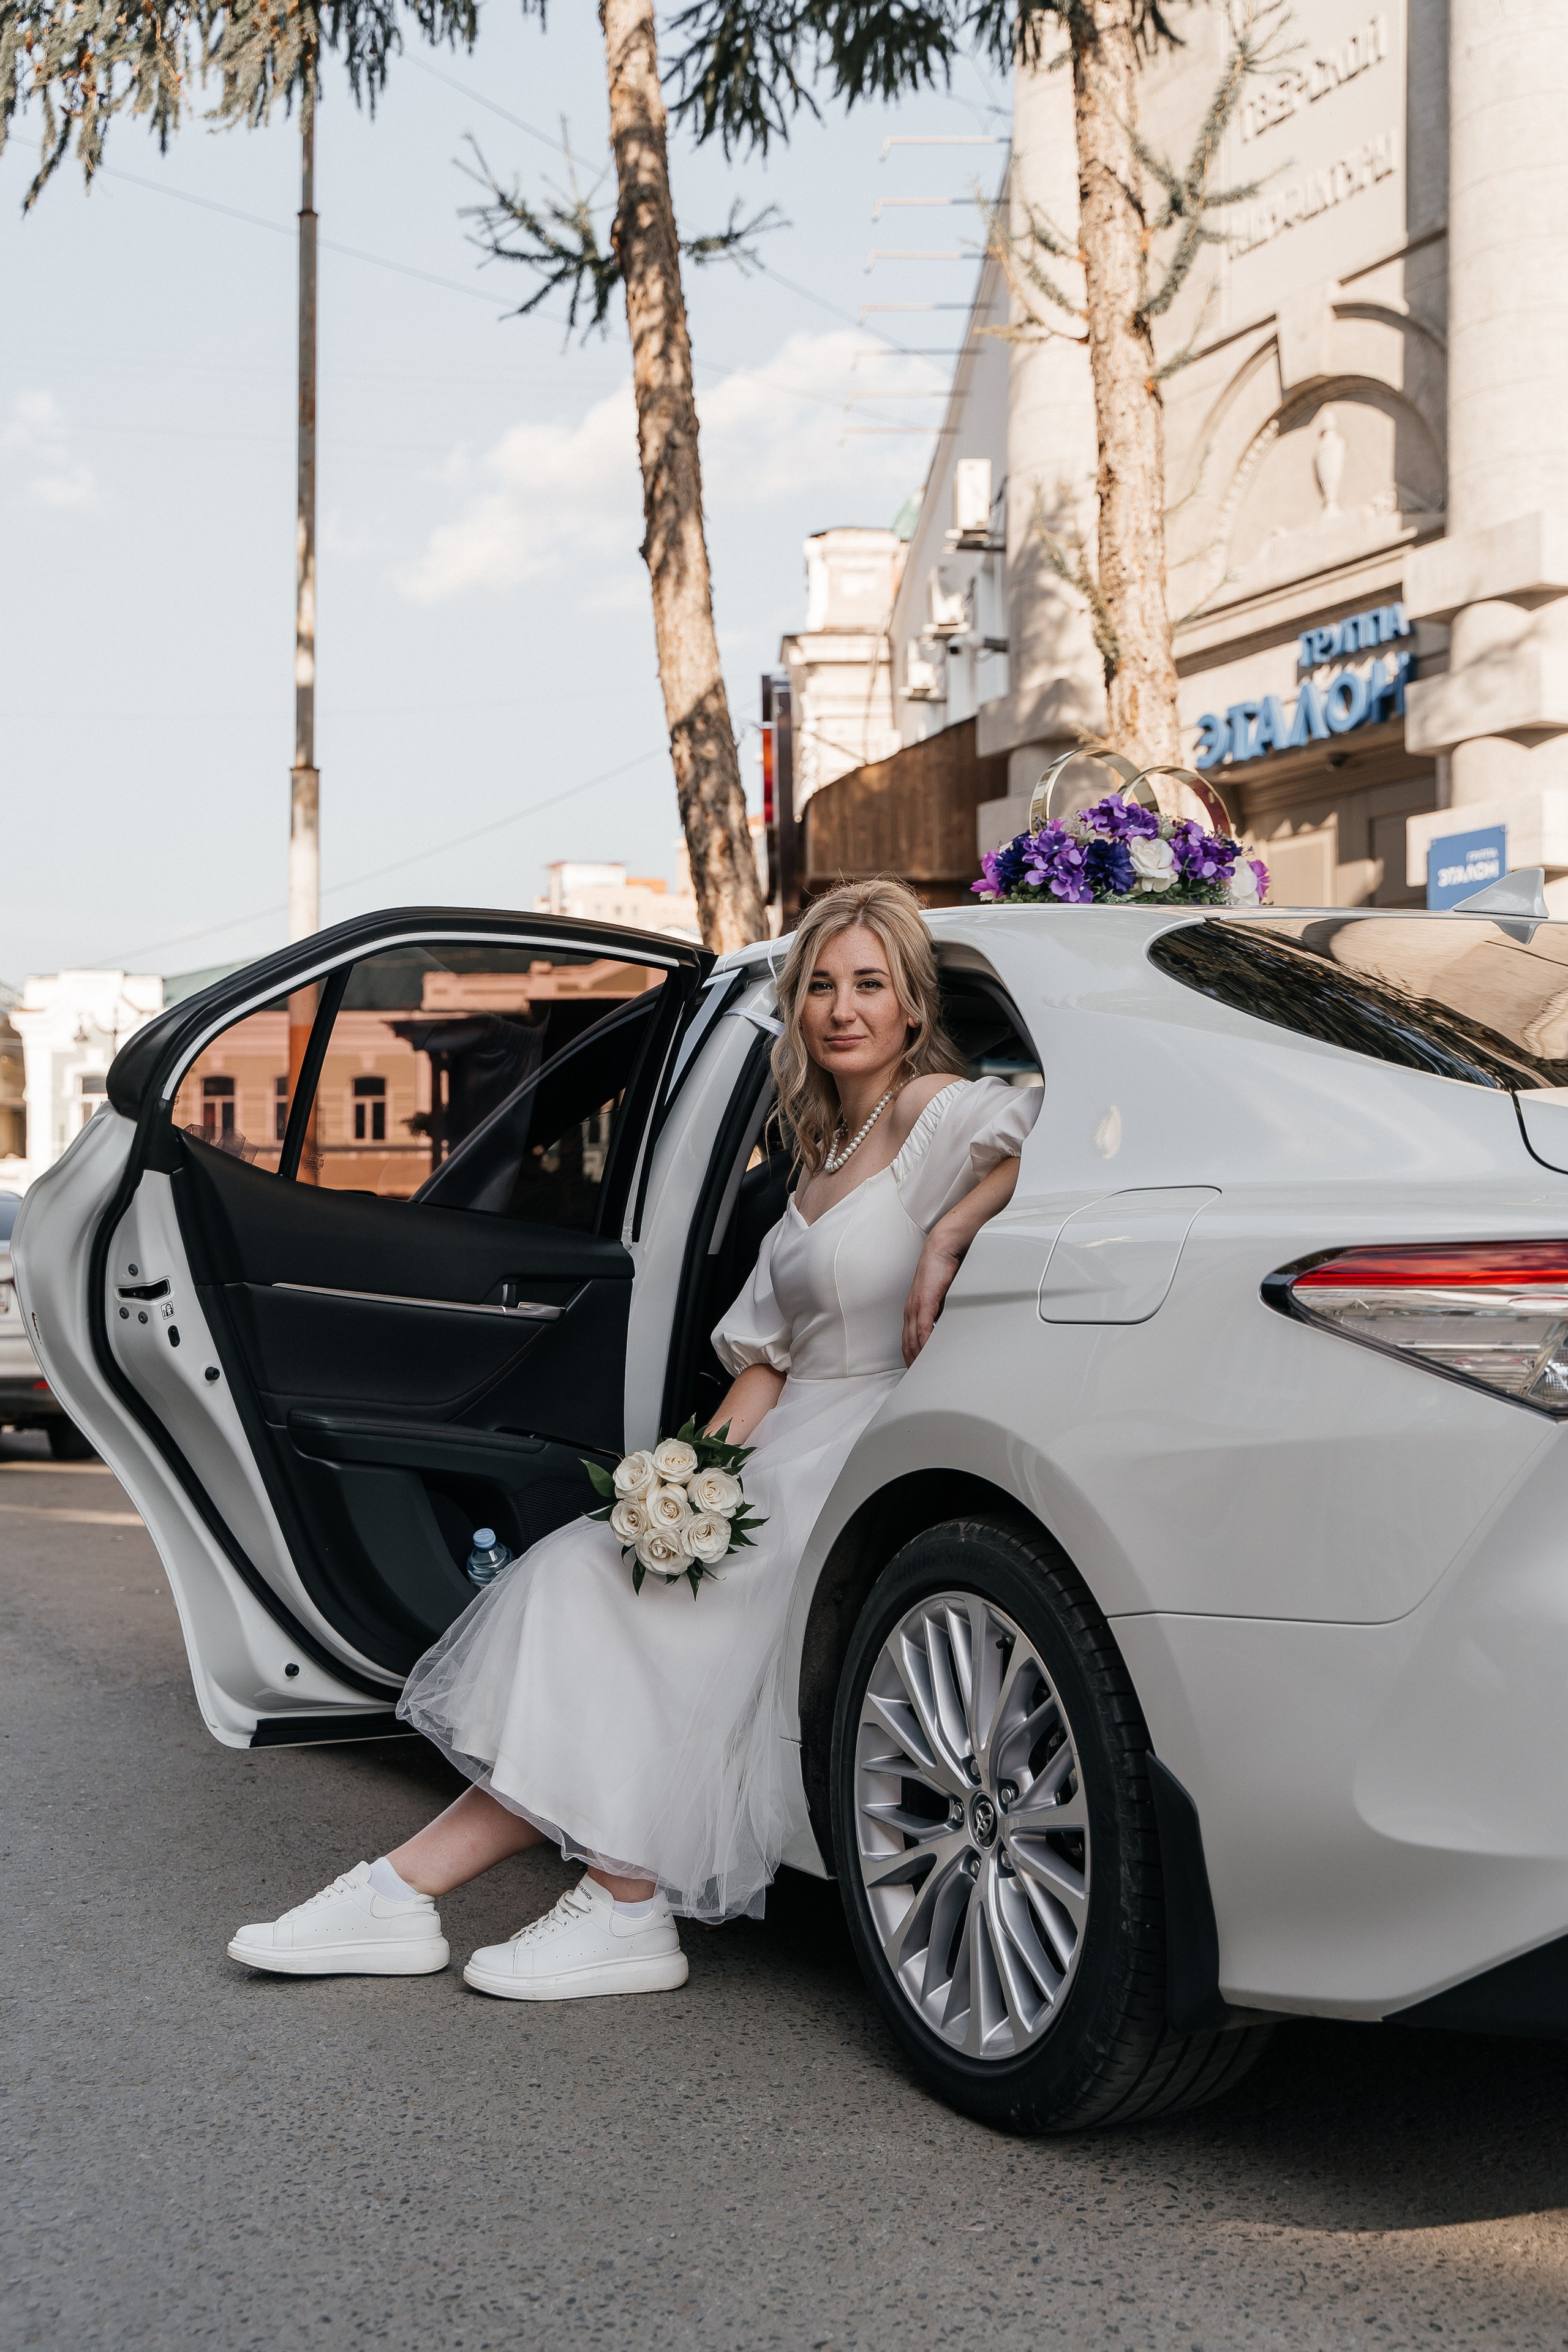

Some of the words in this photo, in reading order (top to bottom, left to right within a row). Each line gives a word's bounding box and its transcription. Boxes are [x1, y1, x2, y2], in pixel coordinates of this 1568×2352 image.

[1298, 601, 1410, 667] ГРУППА
[1195, 650, 1411, 769] ЭТАЛОН
[578, 1885, 593, 1900] FASHION
